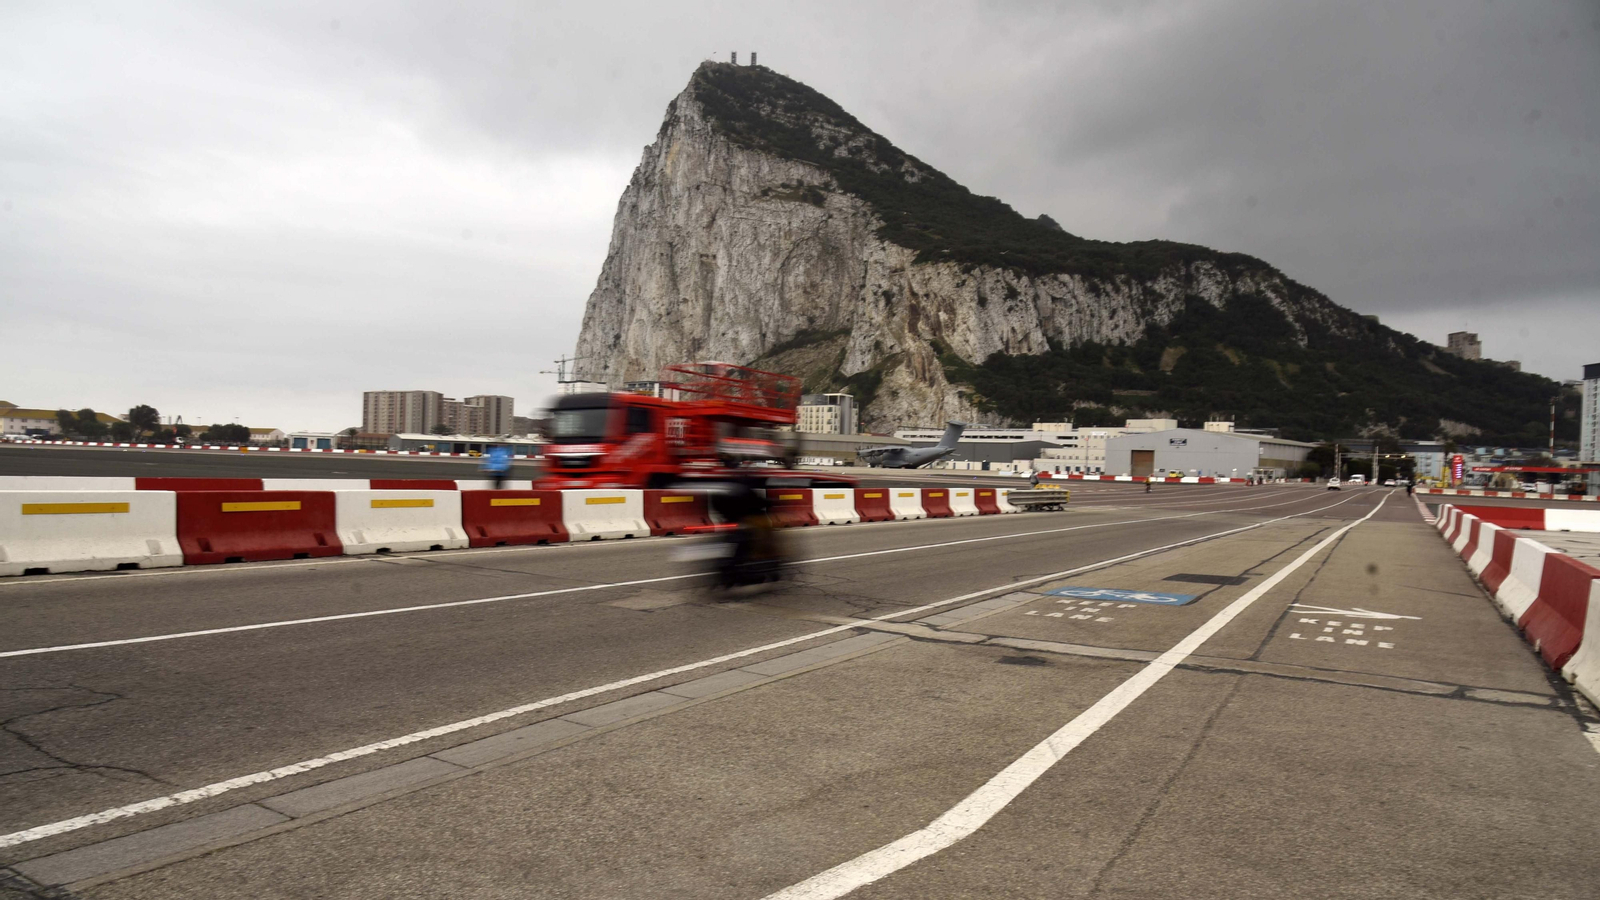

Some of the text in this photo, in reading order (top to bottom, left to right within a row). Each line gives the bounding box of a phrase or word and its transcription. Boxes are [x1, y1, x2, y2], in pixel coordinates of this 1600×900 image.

[1056, 599, 1137, 609] KEEP
[1024, 610, 1115, 623] LANE
[1298, 618, 1394, 631] KEEP
[1322, 627, 1364, 636] IN
[1288, 633, 1396, 649] LANE
